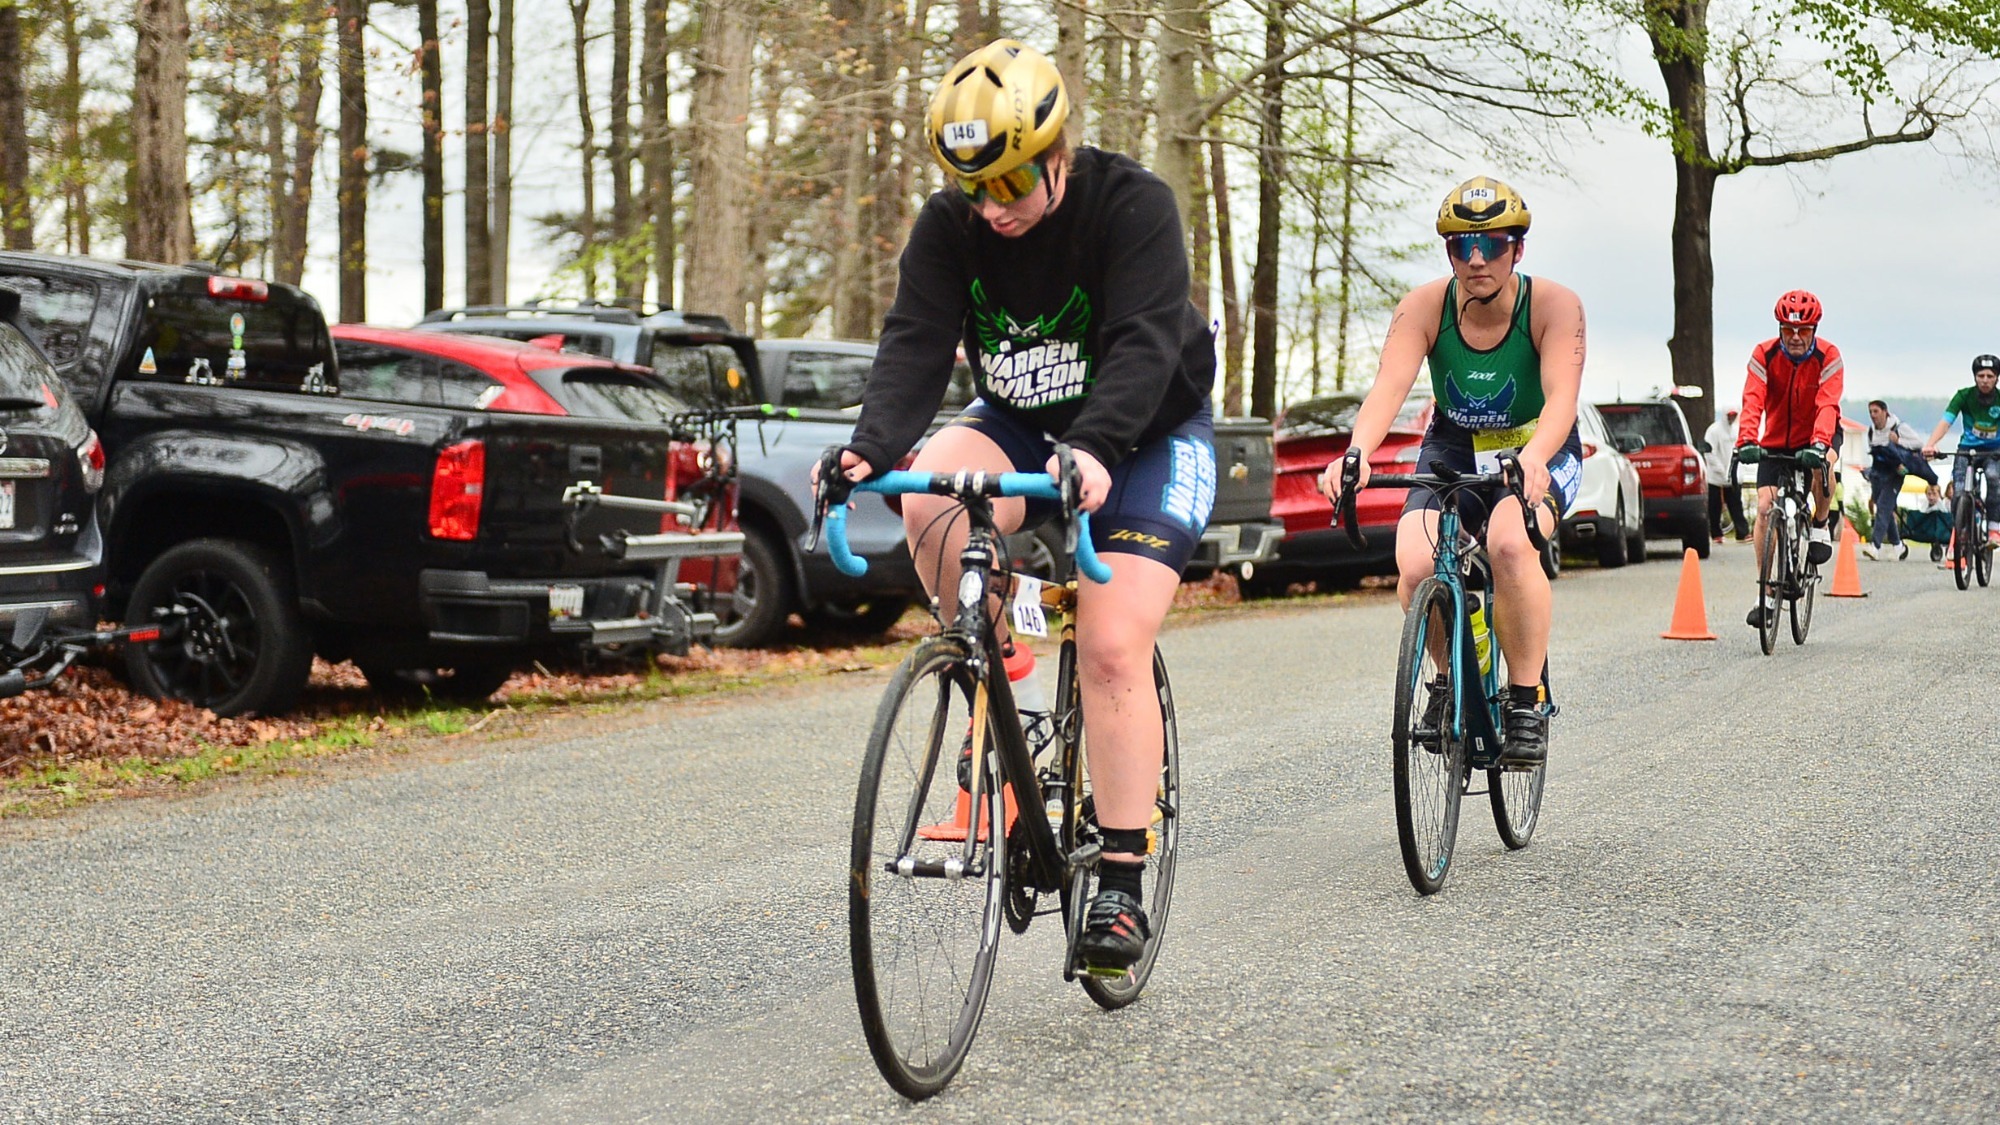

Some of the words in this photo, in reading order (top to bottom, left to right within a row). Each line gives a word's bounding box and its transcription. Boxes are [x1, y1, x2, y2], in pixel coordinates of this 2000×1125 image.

[952, 123, 976, 140] 146
[1470, 188, 1488, 198] 145
[979, 341, 1080, 380] WARREN
[986, 360, 1087, 399] WILSON
[1447, 409, 1508, 424] WARREN
[1018, 605, 1041, 632] 146
